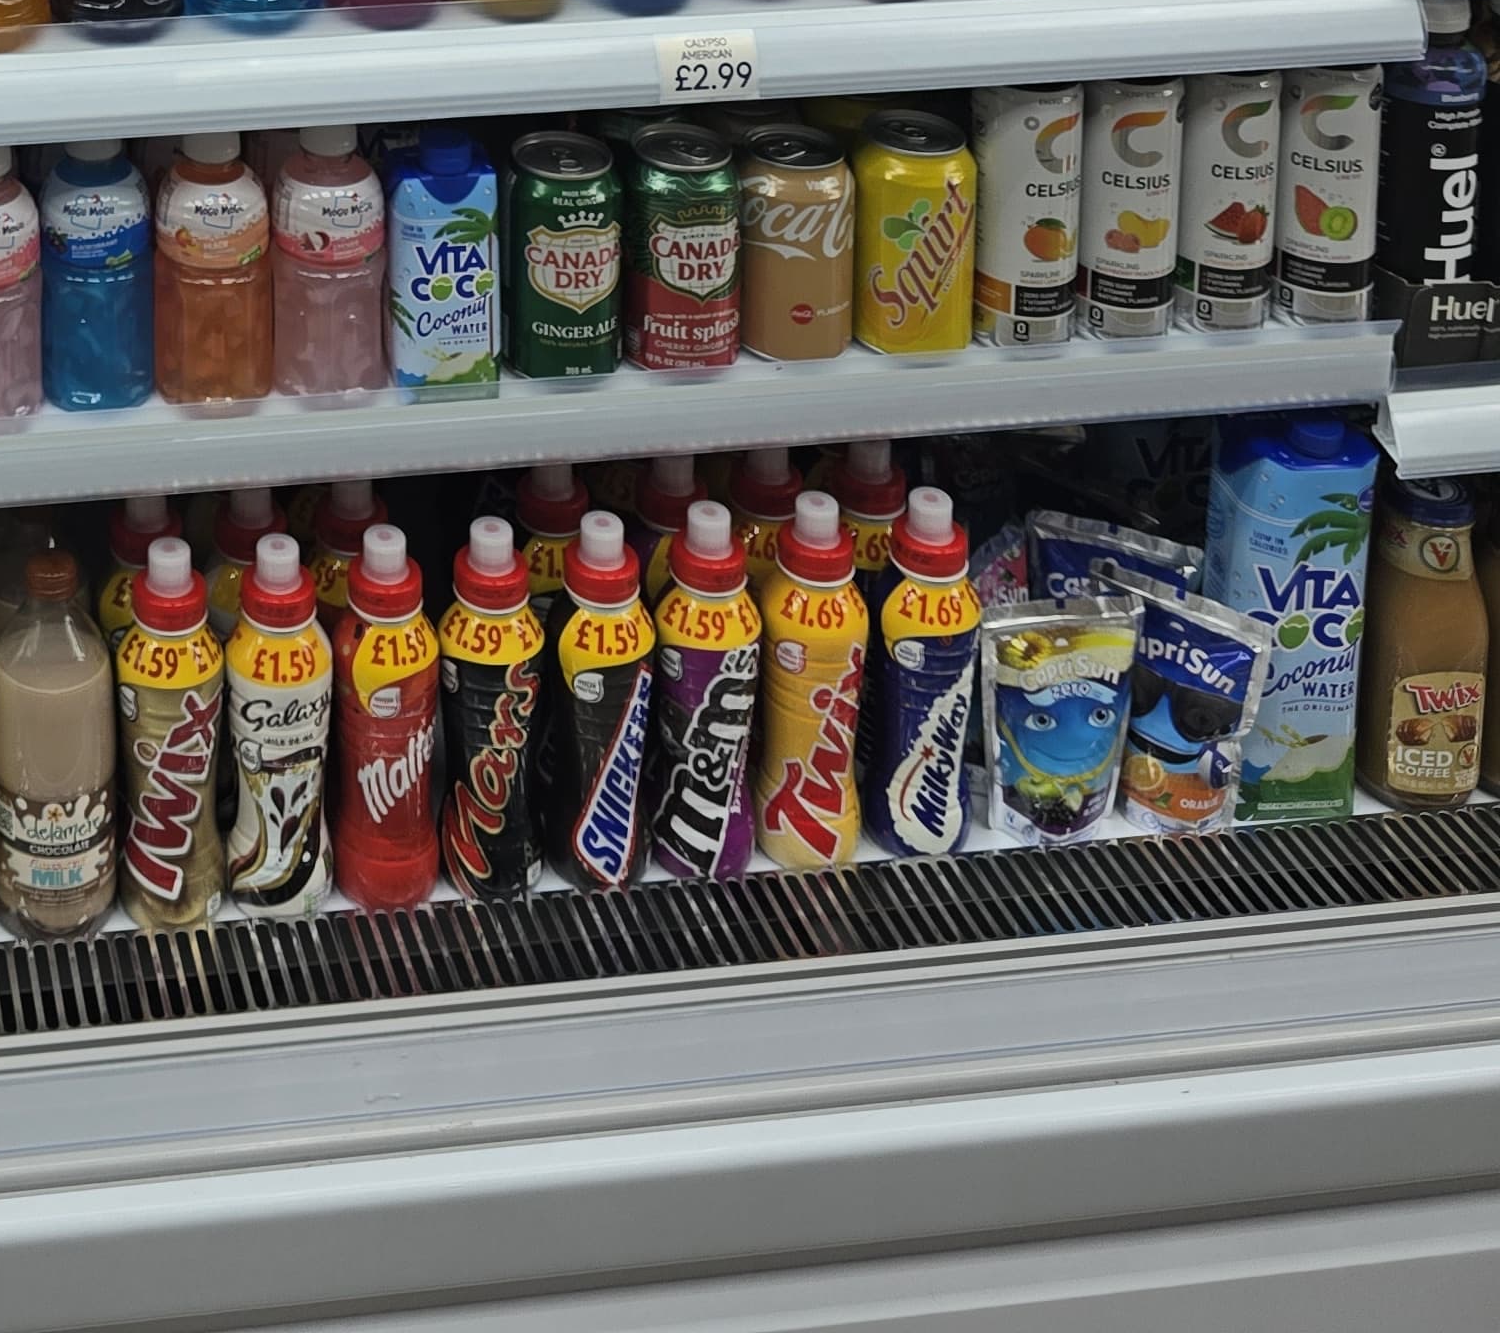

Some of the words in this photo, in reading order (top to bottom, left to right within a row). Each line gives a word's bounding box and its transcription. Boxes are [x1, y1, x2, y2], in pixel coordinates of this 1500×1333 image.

[681, 47, 732, 62] AMERICAN
[684, 37, 727, 49] CALYPSO
[675, 61, 752, 91] £2.99
[1211, 162, 1275, 181] CELSIUS
[1290, 151, 1364, 174] CELSIUS
[1101, 171, 1171, 191] CELSIUS
[1424, 153, 1479, 286] Huel
[415, 242, 486, 275] VITA
[524, 242, 620, 267] CANADA
[651, 235, 740, 259] CANADA
[870, 180, 970, 328] Squirt
[554, 268, 604, 290] DRY
[677, 260, 726, 281] DRY
[1430, 296, 1493, 323] Huel
[451, 322, 488, 336] WATER
[532, 321, 594, 338] GINGER
[595, 317, 619, 334] ALE
[1255, 565, 1362, 615] VITA
[780, 589, 844, 630] £1.69
[899, 588, 961, 626] £1.69
[371, 624, 427, 668] £1.59
[122, 638, 179, 680] £1.59
[251, 645, 315, 684] £1.59
[1302, 680, 1354, 699] WATER
[240, 692, 331, 732] Galaxy
[1395, 747, 1454, 766] ICED
[443, 661, 540, 880] Mars
[1394, 764, 1451, 779] COFFEE
[28, 838, 91, 854] CHOCOLATE
